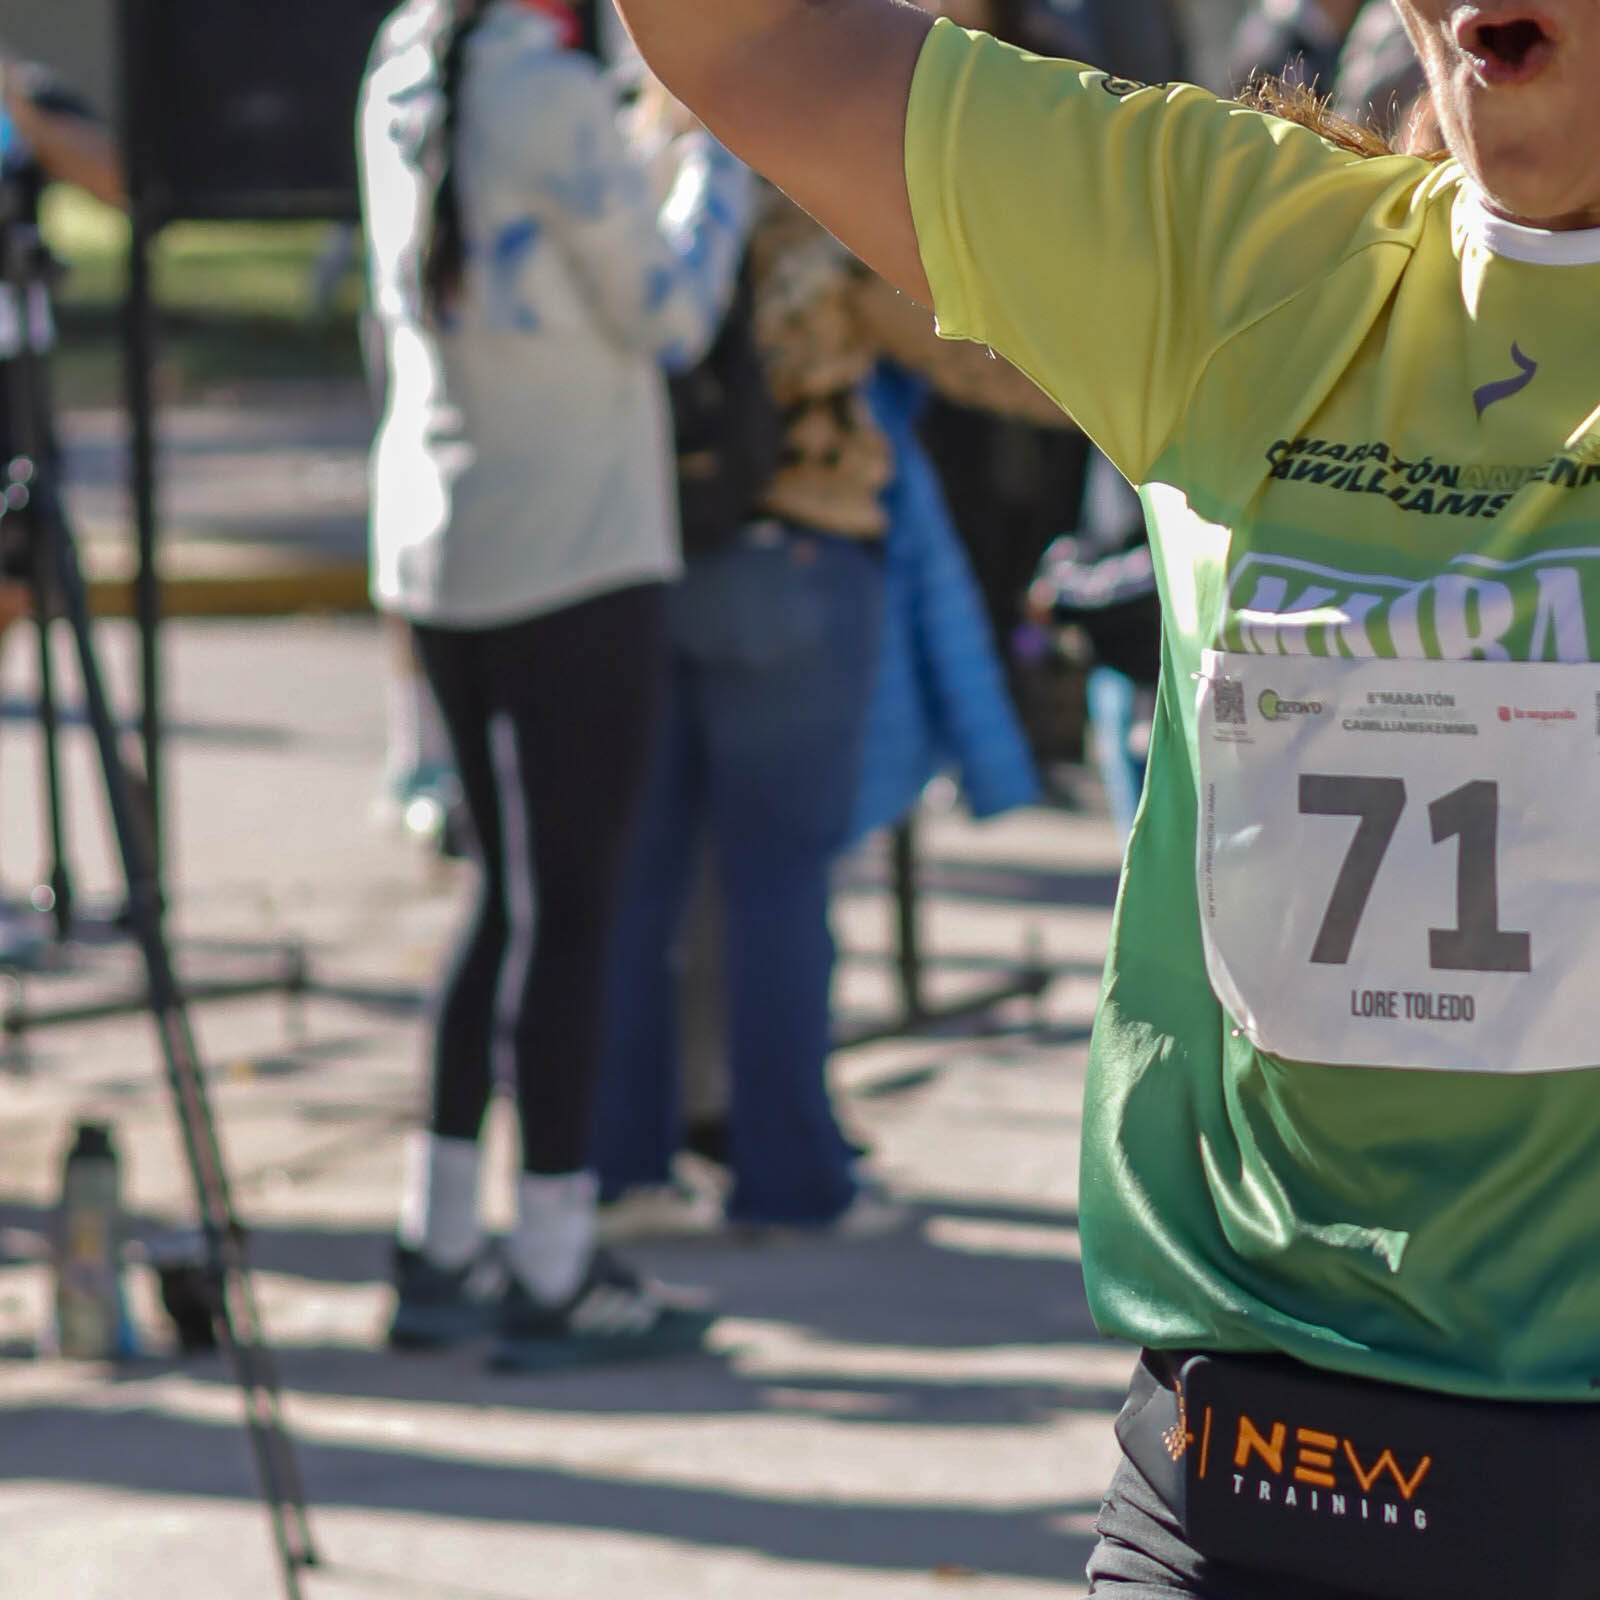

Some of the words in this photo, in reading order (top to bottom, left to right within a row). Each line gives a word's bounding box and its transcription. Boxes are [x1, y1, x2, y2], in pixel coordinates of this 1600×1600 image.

[1297, 773, 1532, 972] 71
[1350, 988, 1399, 1018] LORE
[1402, 991, 1476, 1022] TOLEDO
[1233, 1414, 1433, 1500] NEW
[1232, 1472, 1428, 1531] TRAINING
